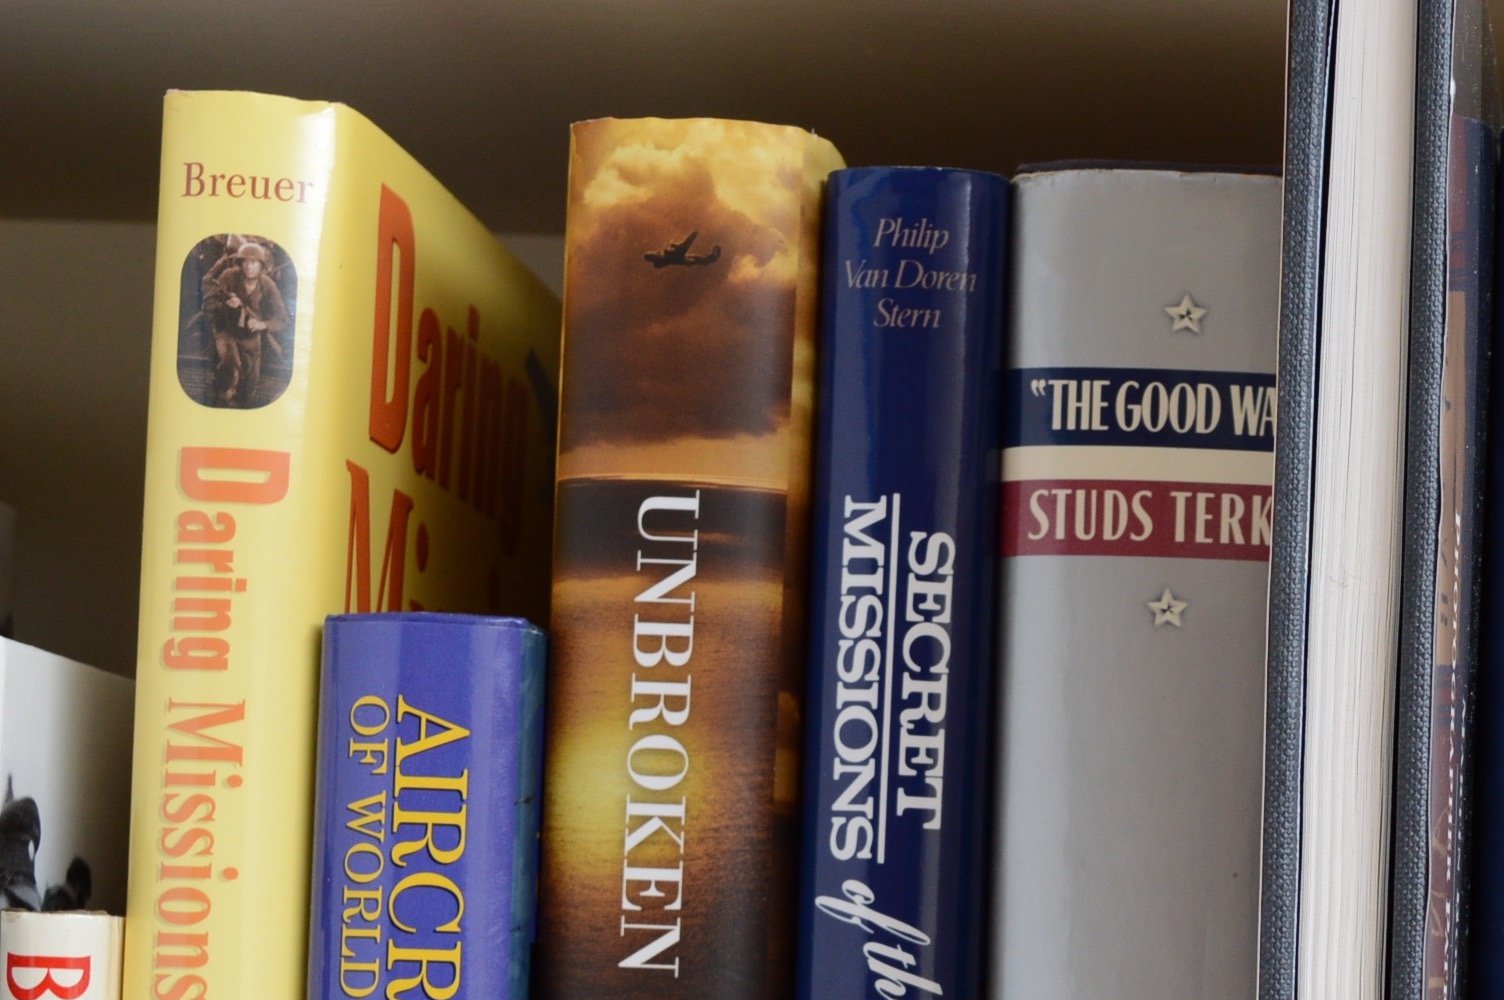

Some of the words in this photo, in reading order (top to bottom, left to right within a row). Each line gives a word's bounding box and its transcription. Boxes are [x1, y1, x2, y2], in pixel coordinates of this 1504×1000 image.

[181, 161, 314, 204] Breuer
[873, 217, 949, 255] Philip
[845, 259, 889, 288] Van
[894, 259, 976, 292] Doren
[873, 298, 941, 328] Stern
[369, 182, 528, 556] Daring
[1115, 380, 1221, 434] GOOD
[1229, 384, 1276, 437] WA
[1028, 488, 1153, 541] STUDS
[1170, 491, 1273, 546] TERK
[162, 446, 290, 672] Daring
[829, 495, 887, 861] MISSIONS
[896, 530, 956, 830] SECRET
[348, 695, 390, 774] OF
[618, 489, 700, 979] UNBROKEN
[338, 796, 386, 998] WORLD
[815, 879, 931, 945] of
